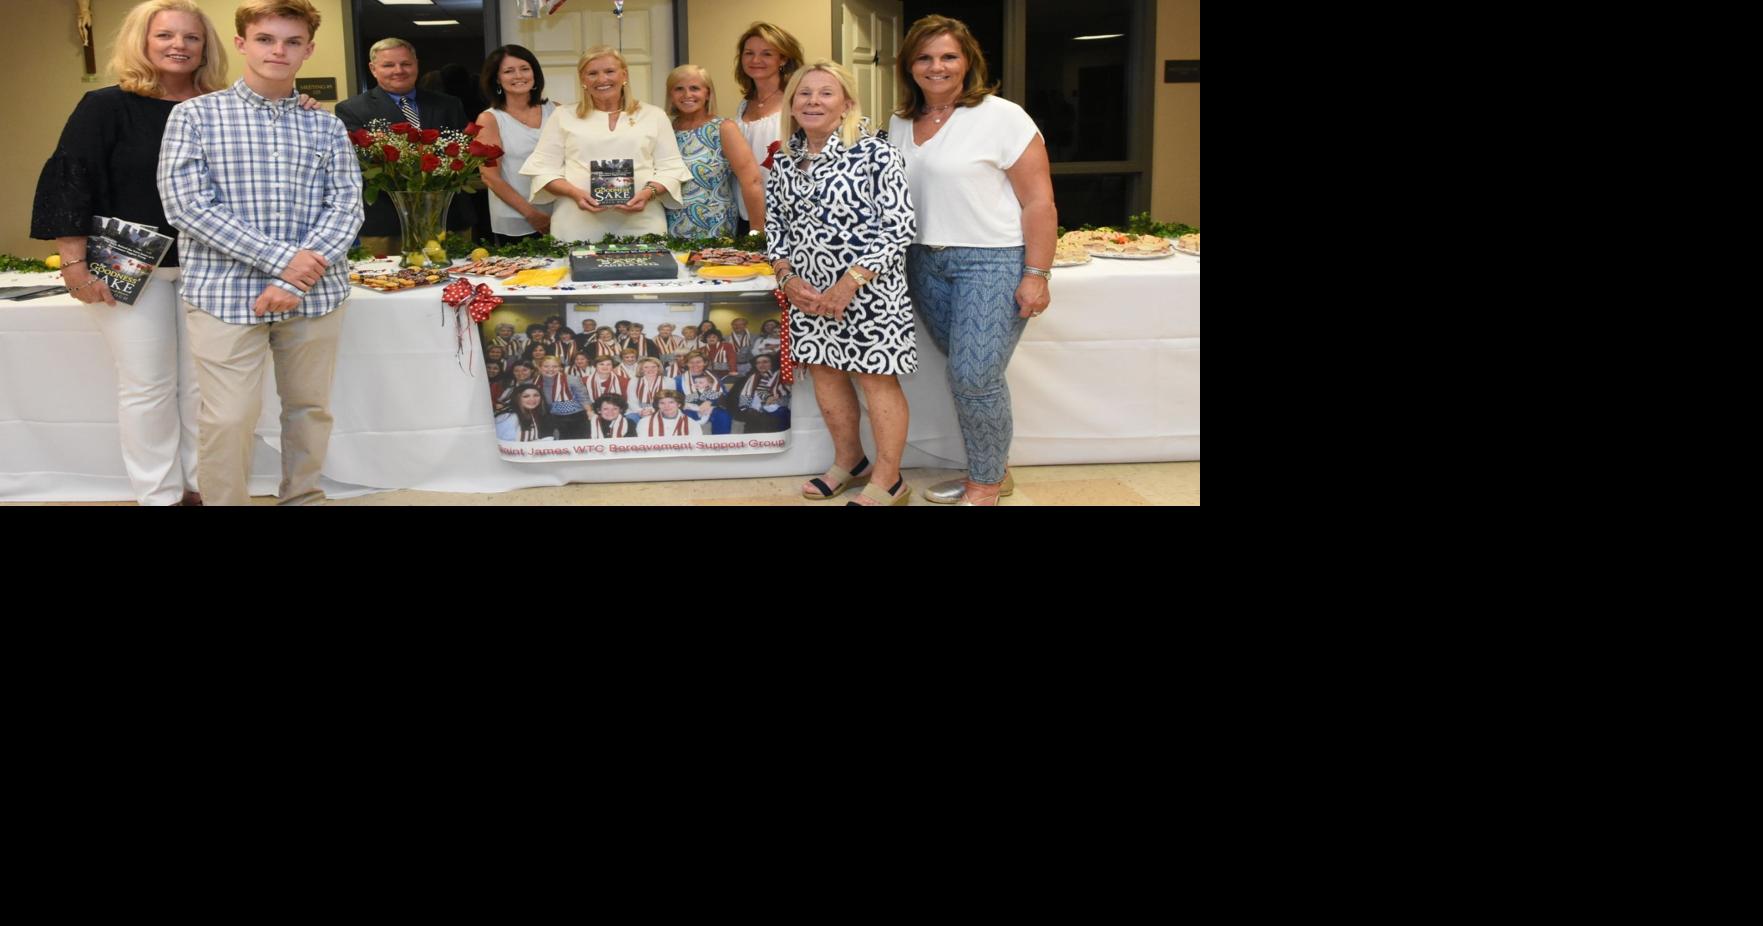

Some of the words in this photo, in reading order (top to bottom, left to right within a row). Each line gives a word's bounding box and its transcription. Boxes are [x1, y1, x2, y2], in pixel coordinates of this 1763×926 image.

[595, 191, 630, 202] SAKE
[528, 447, 570, 456] James
[573, 444, 604, 453] WTC
[609, 441, 692, 452] Bereavement
[696, 441, 744, 450] Support
[748, 439, 785, 448] Group
